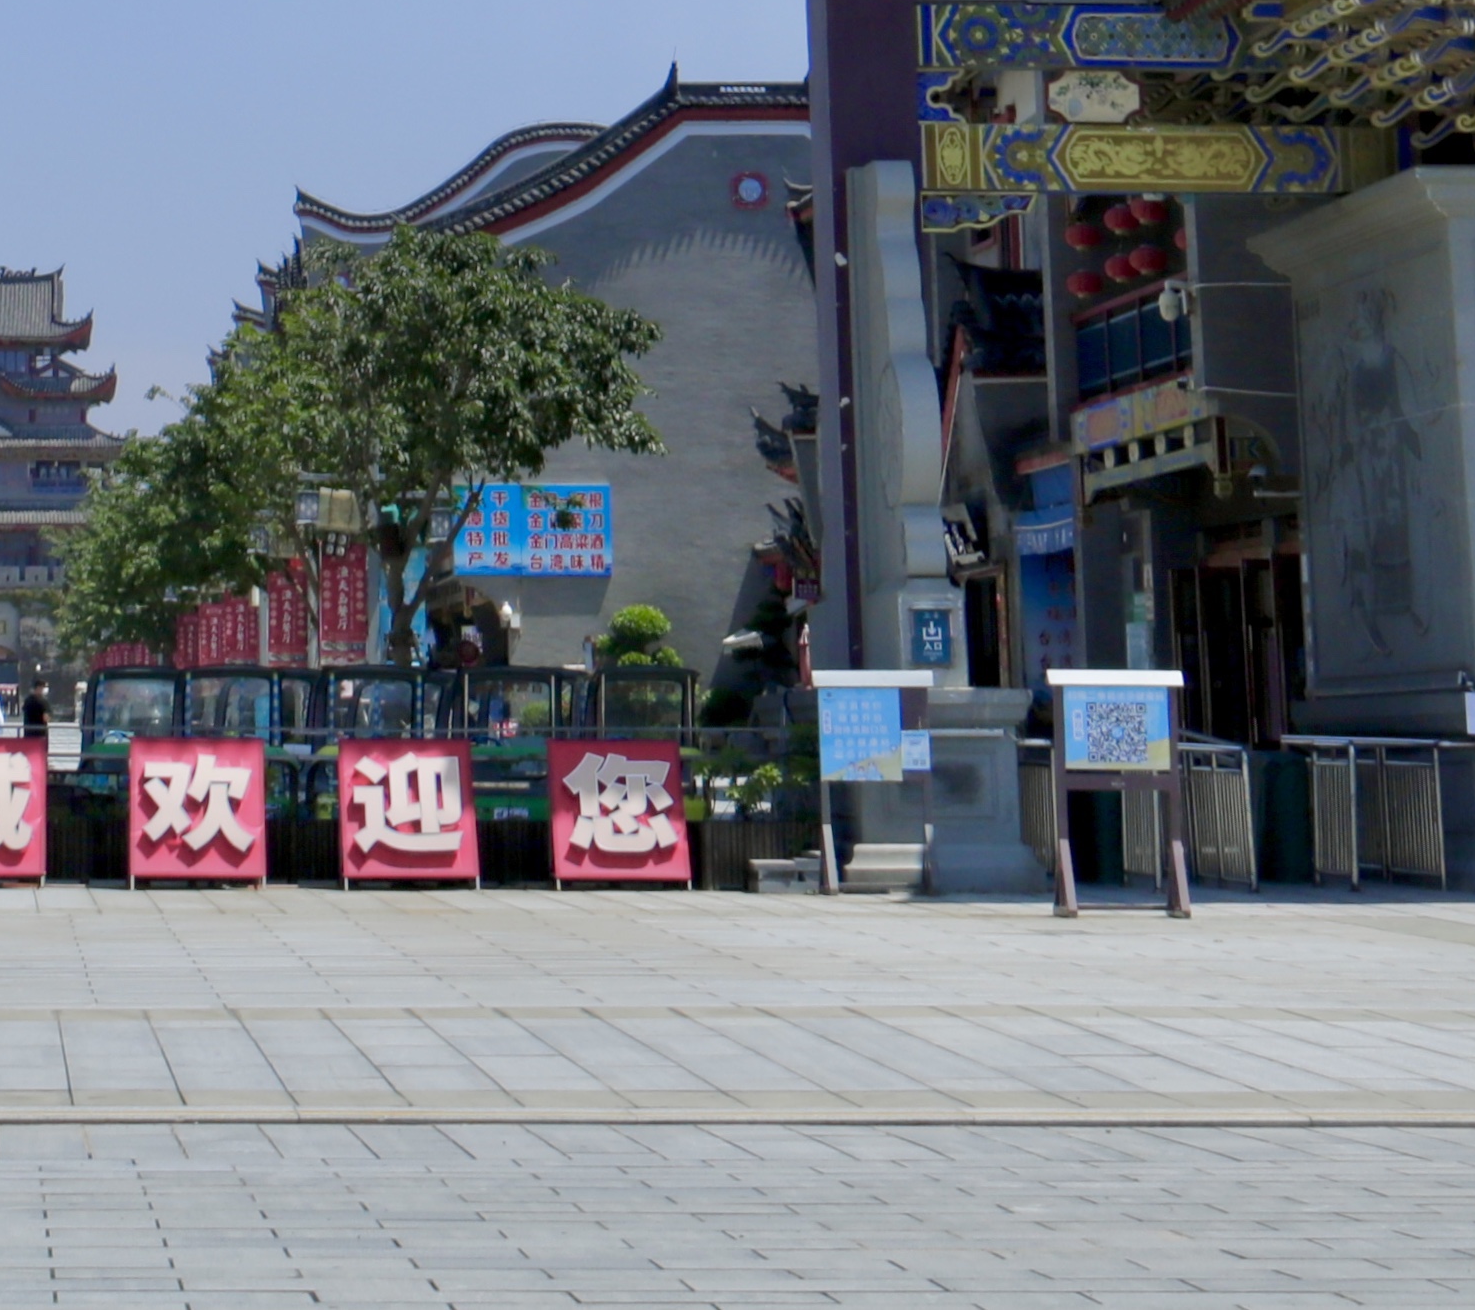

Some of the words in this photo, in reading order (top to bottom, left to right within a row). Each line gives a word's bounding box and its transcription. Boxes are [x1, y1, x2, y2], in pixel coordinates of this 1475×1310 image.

[465, 493, 485, 567] 潭特产
[490, 491, 510, 568] 干货批发
[527, 533, 605, 551] 金门高粱酒
[529, 553, 606, 571] 台湾味精
[924, 641, 943, 651] 入口
